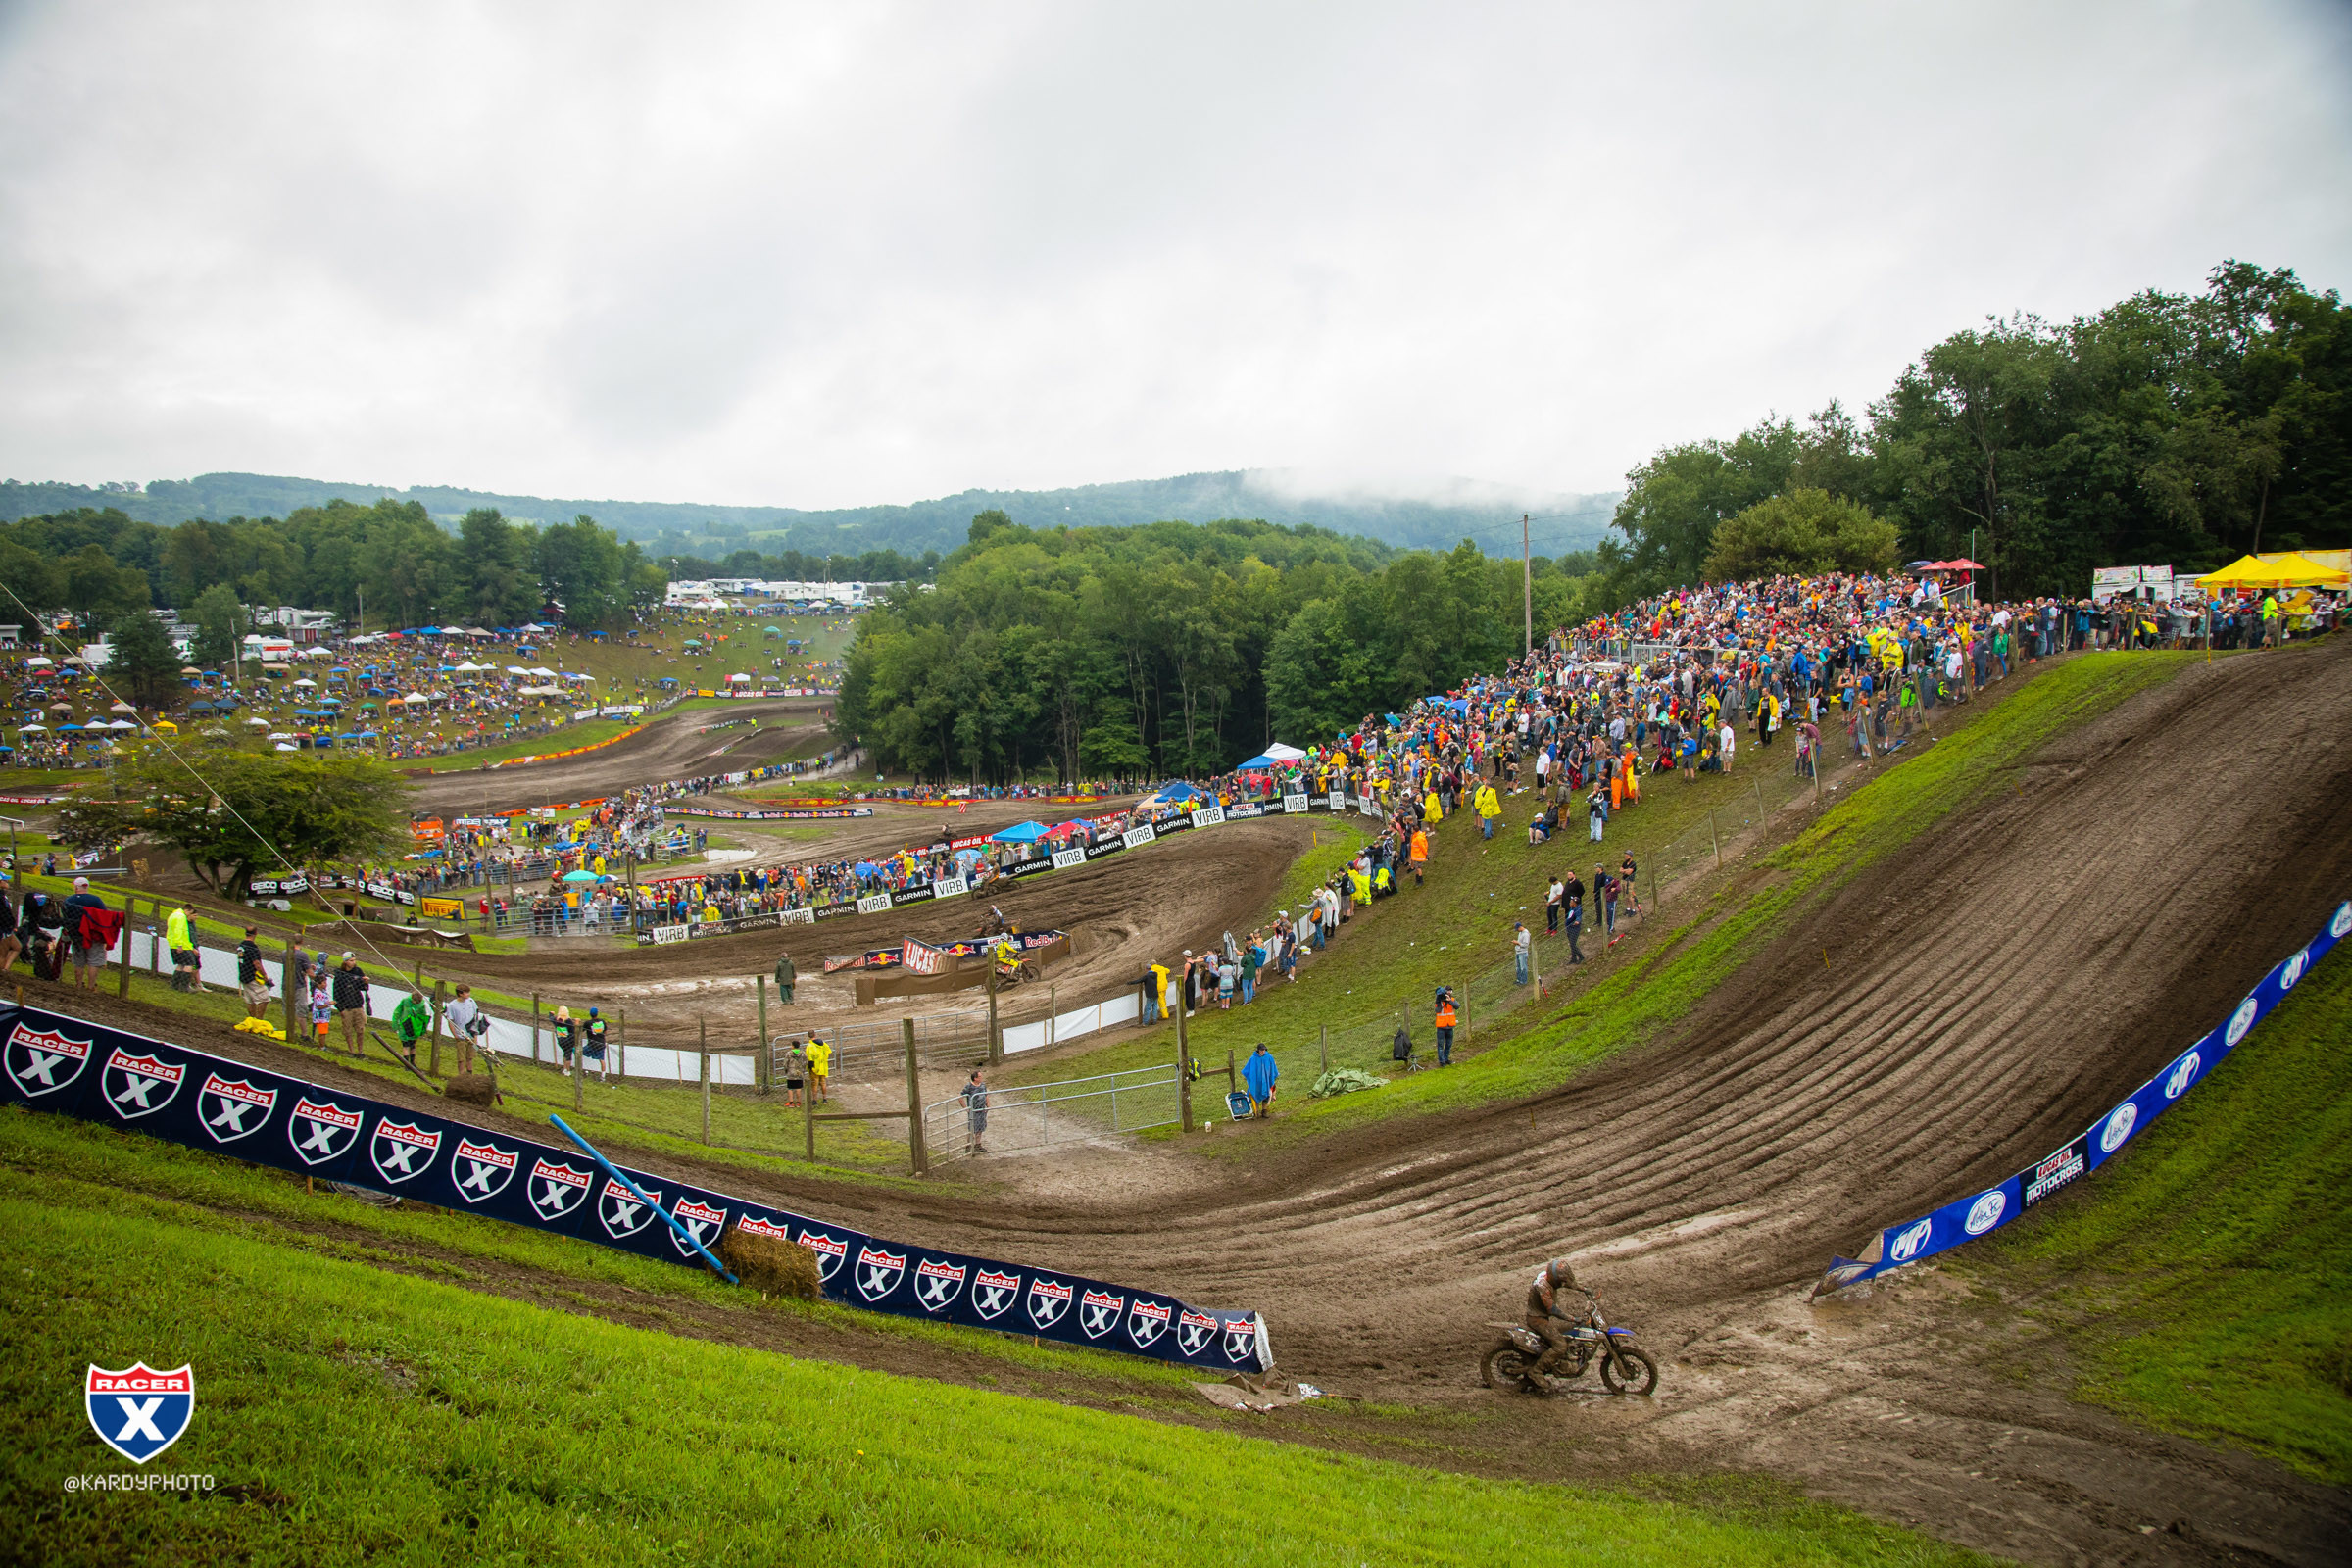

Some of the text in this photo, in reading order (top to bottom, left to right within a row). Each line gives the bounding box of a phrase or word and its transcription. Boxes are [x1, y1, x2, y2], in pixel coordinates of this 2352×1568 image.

[1264, 802, 1283, 811] RMIN
[1287, 796, 1306, 810] VIRB
[1331, 794, 1343, 806] VIRB
[1195, 808, 1221, 825] VIRB
[1227, 808, 1262, 817] MOTOCROSS
[1156, 817, 1192, 833] GARMIN
[952, 839, 971, 849] LUCAS
[1126, 827, 1152, 846] VIRB
[1088, 839, 1123, 856] GARMIN
[1014, 858, 1052, 875] GARMIN
[1055, 850, 1082, 866] VIRB
[251, 880, 276, 890] GEICO
[280, 878, 307, 890] GEICO
[368, 883, 394, 897] GEICO
[938, 878, 964, 896] VIRB
[894, 888, 931, 902] GARMIN
[817, 906, 855, 917] GARMIN
[860, 896, 888, 912] VIRB
[740, 919, 777, 929] GARMIN
[657, 928, 684, 941] VIRB
[1025, 935, 1043, 947] Red
[906, 942, 935, 973] LUCAS
[18, 1031, 84, 1056] RACER
[18, 1049, 65, 1086] X
[115, 1056, 178, 1080] RACER
[114, 1072, 161, 1108] X
[210, 1082, 270, 1103] RACER
[210, 1097, 253, 1133] X
[300, 1104, 357, 1126] RACER
[299, 1121, 341, 1154] X
[382, 1125, 436, 1147] RACER
[380, 1141, 421, 1174] X
[462, 1146, 513, 1165] RACER
[2038, 1150, 2071, 1178] LUCAS OIL
[462, 1160, 499, 1192] X
[537, 1166, 586, 1185] RACER
[2027, 1158, 2084, 1201] MOTOCROSS
[537, 1180, 573, 1211] X
[608, 1199, 643, 1229] X
[678, 1205, 722, 1221] RACER
[741, 1219, 783, 1237] RACER
[802, 1237, 843, 1254] RACER
[862, 1253, 902, 1268] RACER
[862, 1265, 892, 1292] X
[921, 1264, 962, 1279] RACER
[923, 1276, 952, 1301] X
[980, 1274, 1017, 1290] RACER
[980, 1286, 1005, 1311] X
[1035, 1284, 1070, 1298] RACER
[1035, 1296, 1060, 1320] X
[1086, 1294, 1121, 1308] RACER
[1087, 1305, 1111, 1330] X
[1135, 1303, 1168, 1319] RACER
[1135, 1317, 1158, 1341] X
[1183, 1313, 1215, 1328] RACER
[1229, 1323, 1254, 1334] RACER
[1183, 1325, 1206, 1348] X
[1234, 1333, 1249, 1354] X
